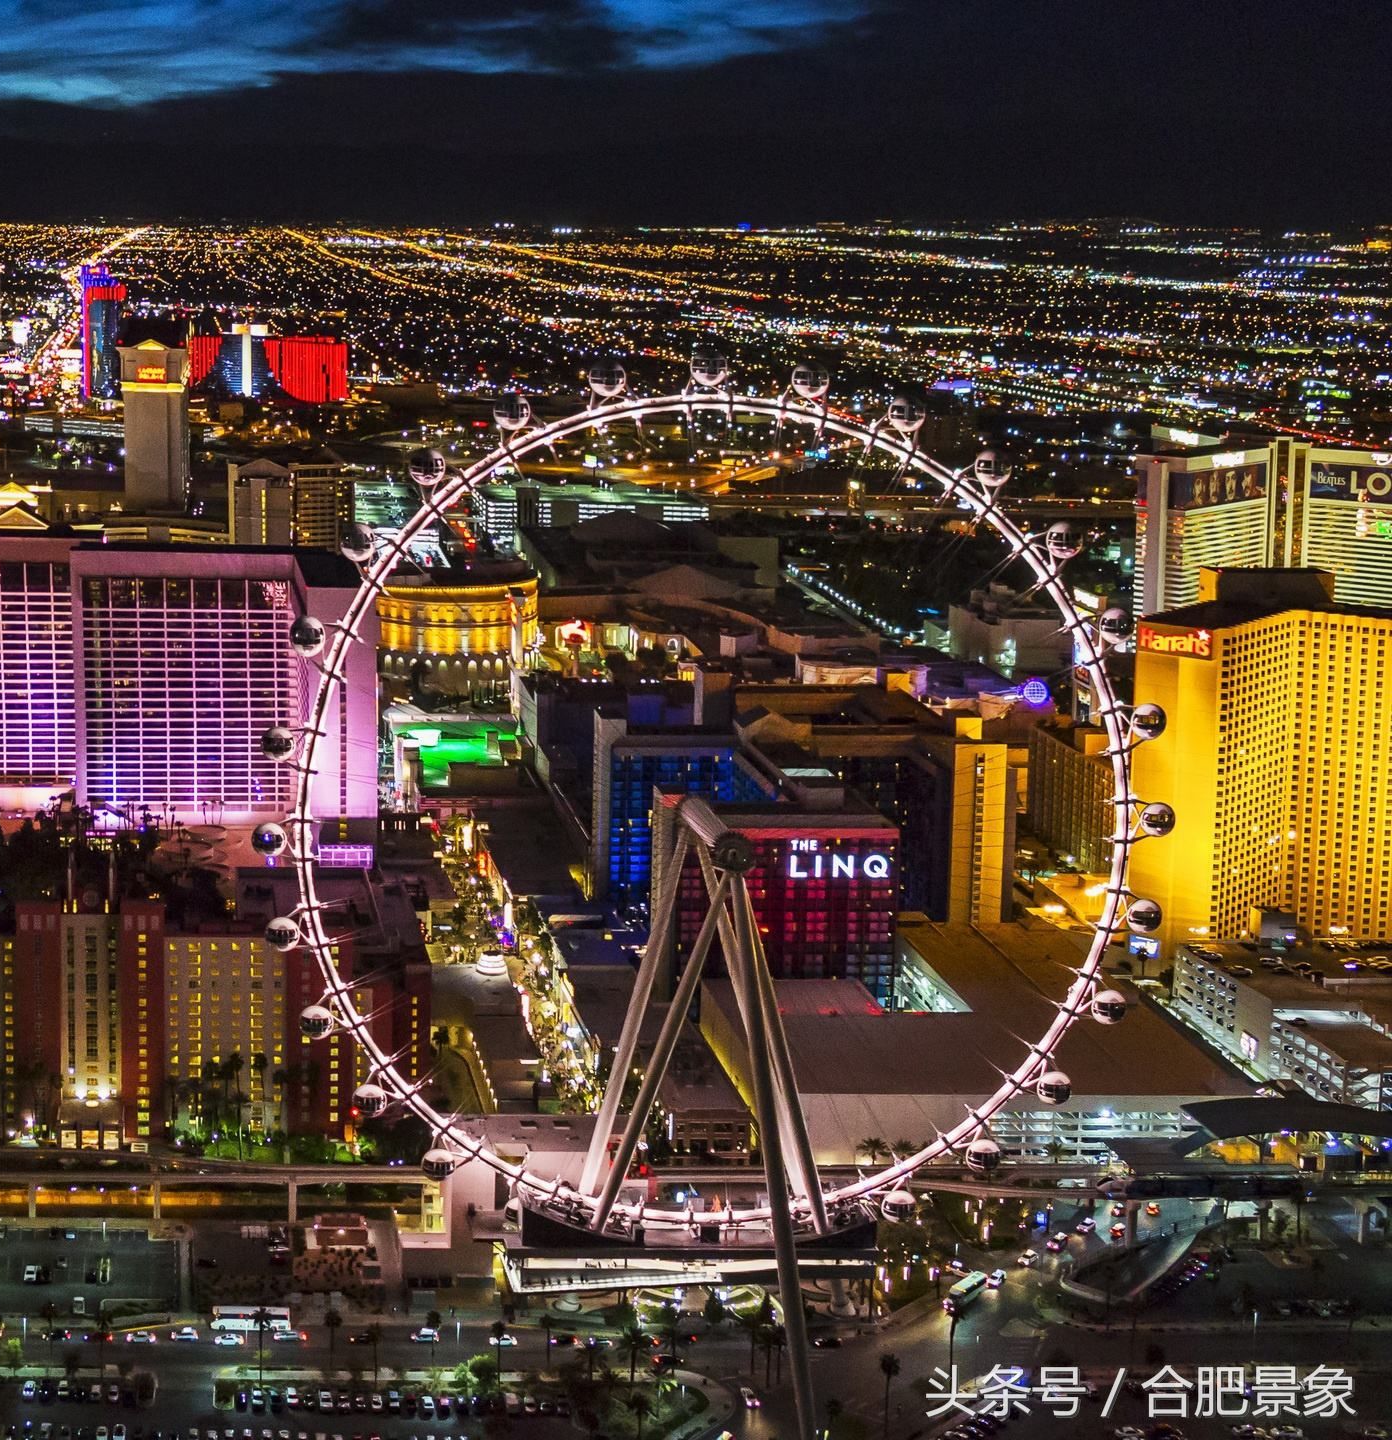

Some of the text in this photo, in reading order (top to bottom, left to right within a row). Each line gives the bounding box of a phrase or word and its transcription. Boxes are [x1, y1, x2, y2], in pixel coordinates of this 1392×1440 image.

[1317, 471, 1346, 487] BEATLES
[790, 839, 818, 852] THE
[789, 853, 889, 879] LINQ
